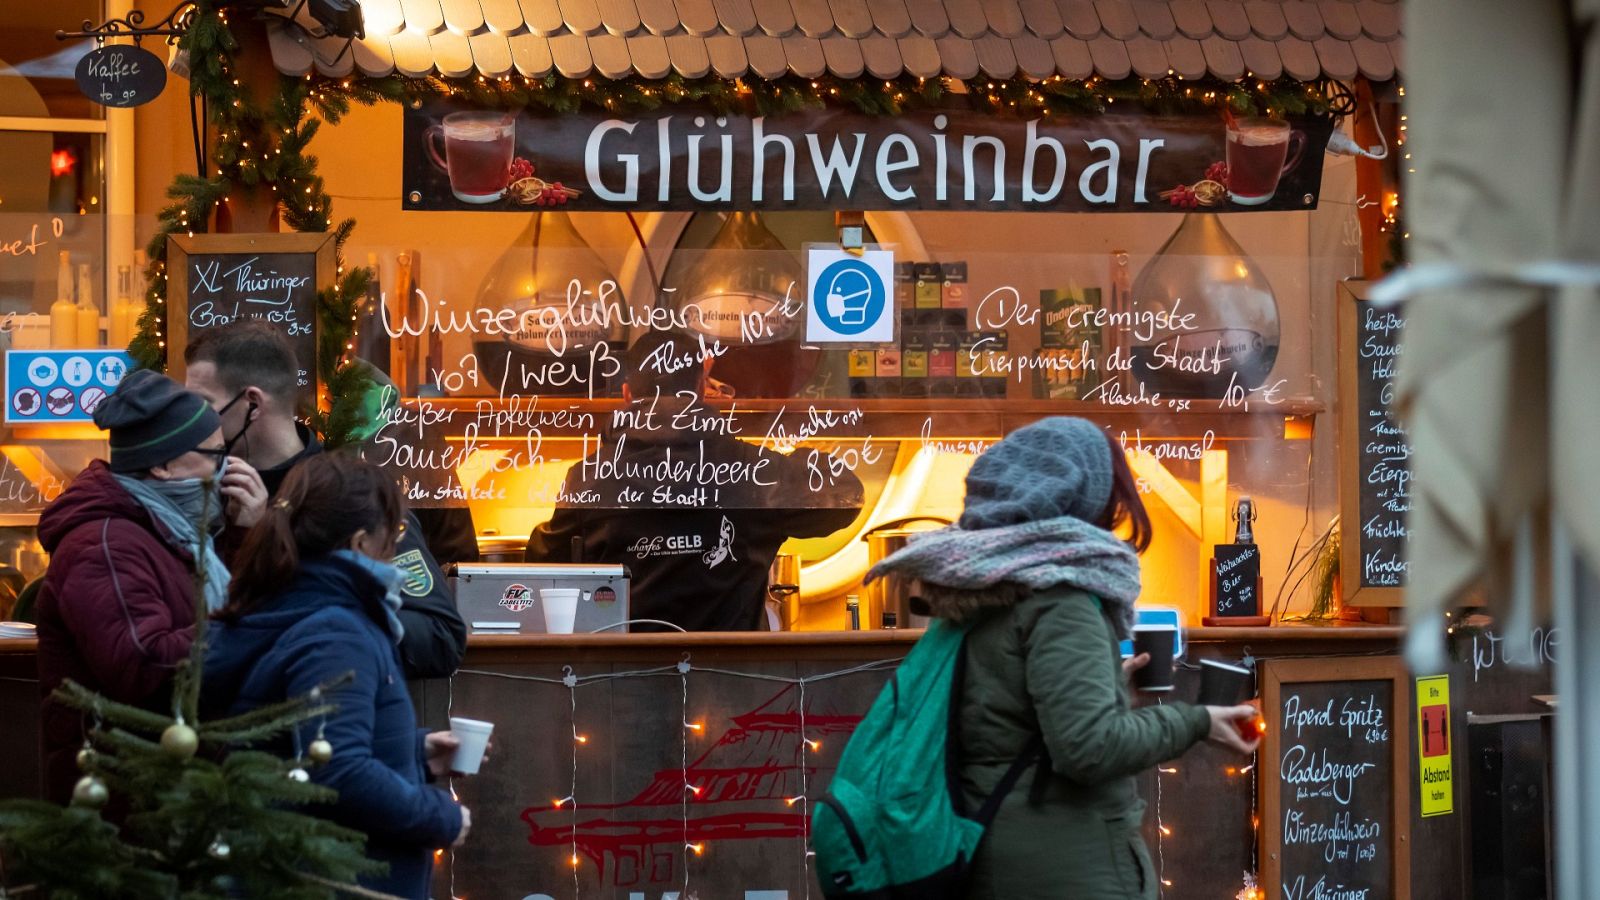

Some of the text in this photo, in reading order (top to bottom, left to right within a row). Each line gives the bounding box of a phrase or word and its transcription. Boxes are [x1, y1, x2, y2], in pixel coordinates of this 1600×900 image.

[88, 53, 140, 82] Kaffee
[100, 83, 136, 105] to go
[584, 114, 1164, 204] Glühweinbar
[193, 256, 310, 305] XL Thüringer
[190, 301, 297, 328] Bratrst
[381, 279, 712, 357] Winzerglühwein
[976, 286, 1040, 330] Der
[639, 334, 728, 374] Flasche
[969, 336, 1231, 383] Eierpunsch der Stadt
[376, 384, 743, 439] heißer Apfelwein mit Zimt
[1081, 376, 1161, 406] Flasche
[582, 432, 778, 486] Holunderbeere
[617, 485, 645, 504] der
[626, 536, 664, 559] scharfes
[666, 535, 703, 549] GELB
[1284, 694, 1384, 738] Aperol Spritz
[1280, 744, 1376, 805] Radeberger
[1423, 765, 1450, 784] Abstand
[1284, 808, 1380, 863] Winzerglühwein
